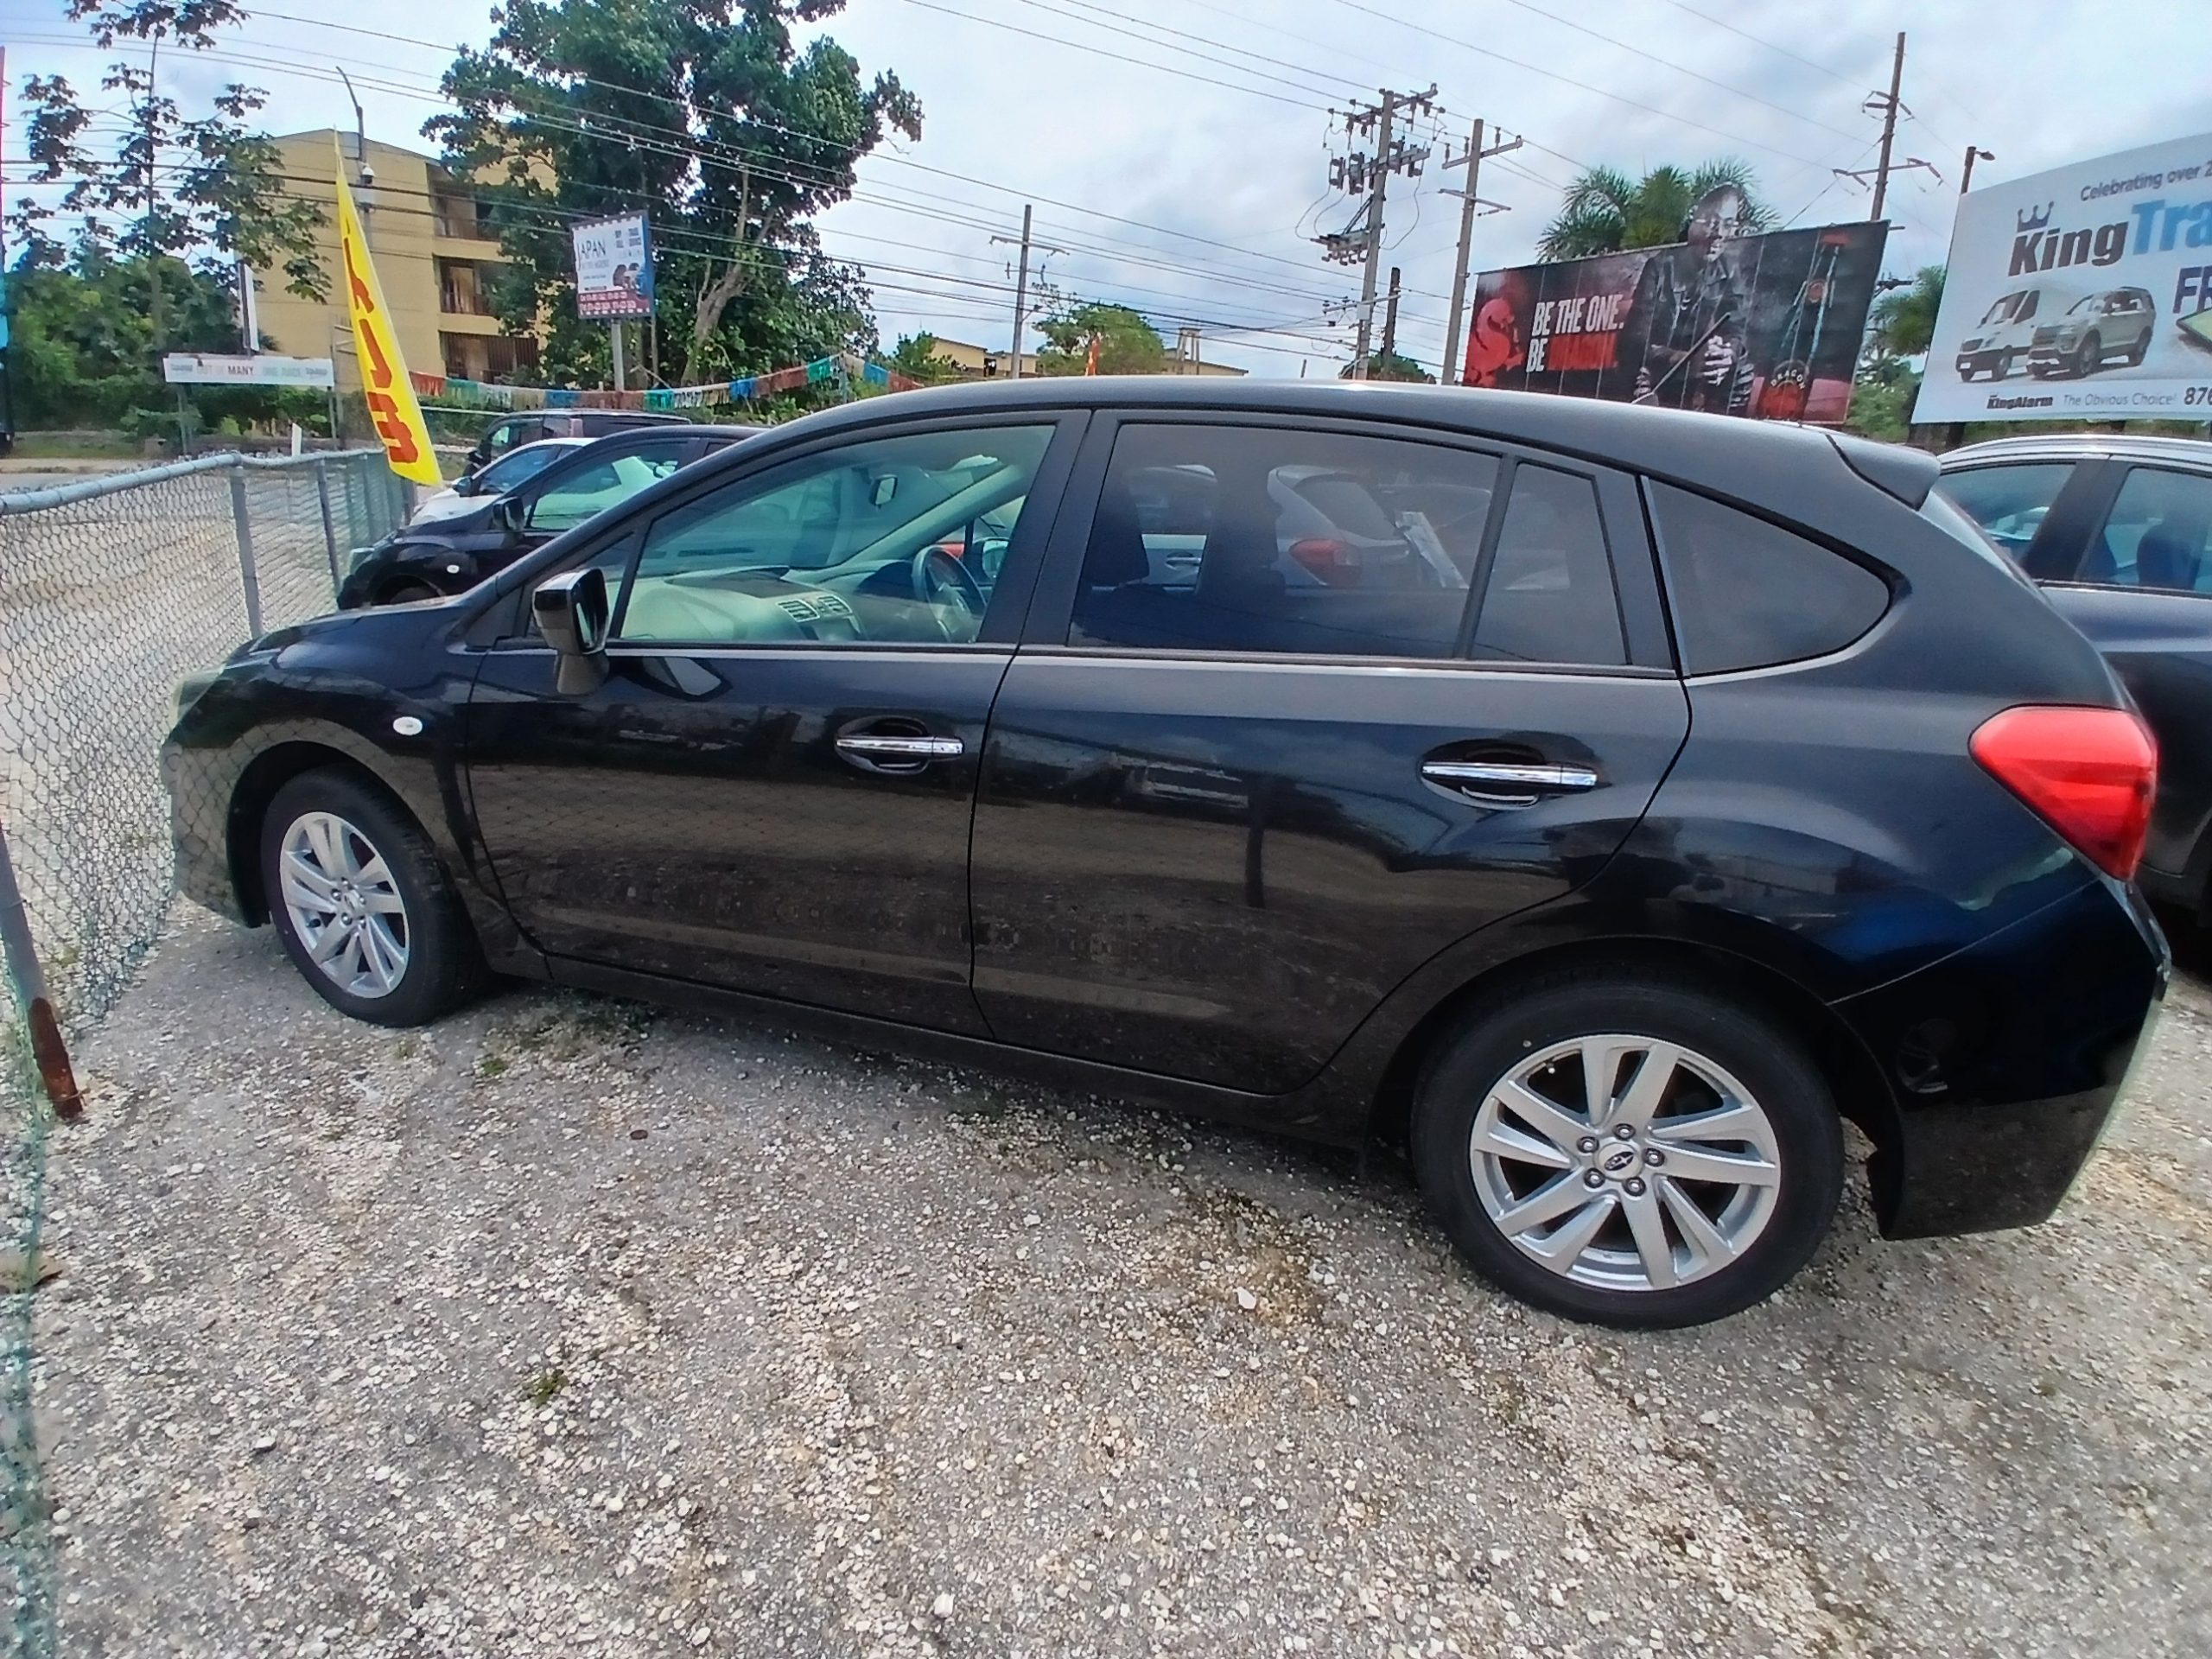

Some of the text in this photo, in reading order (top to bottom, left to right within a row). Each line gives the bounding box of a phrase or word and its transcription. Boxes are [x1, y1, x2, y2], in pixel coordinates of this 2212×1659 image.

[2081, 173, 2164, 201] Celebrating
[2167, 166, 2201, 183] over
[1532, 294, 1624, 336] BE THE ONE.
[1526, 338, 1548, 372] BE
[1770, 369, 1806, 390] DRAGON
[1986, 395, 2054, 410] KingAlarm
[2064, 394, 2081, 406] The
[2084, 393, 2128, 407] Obvious
